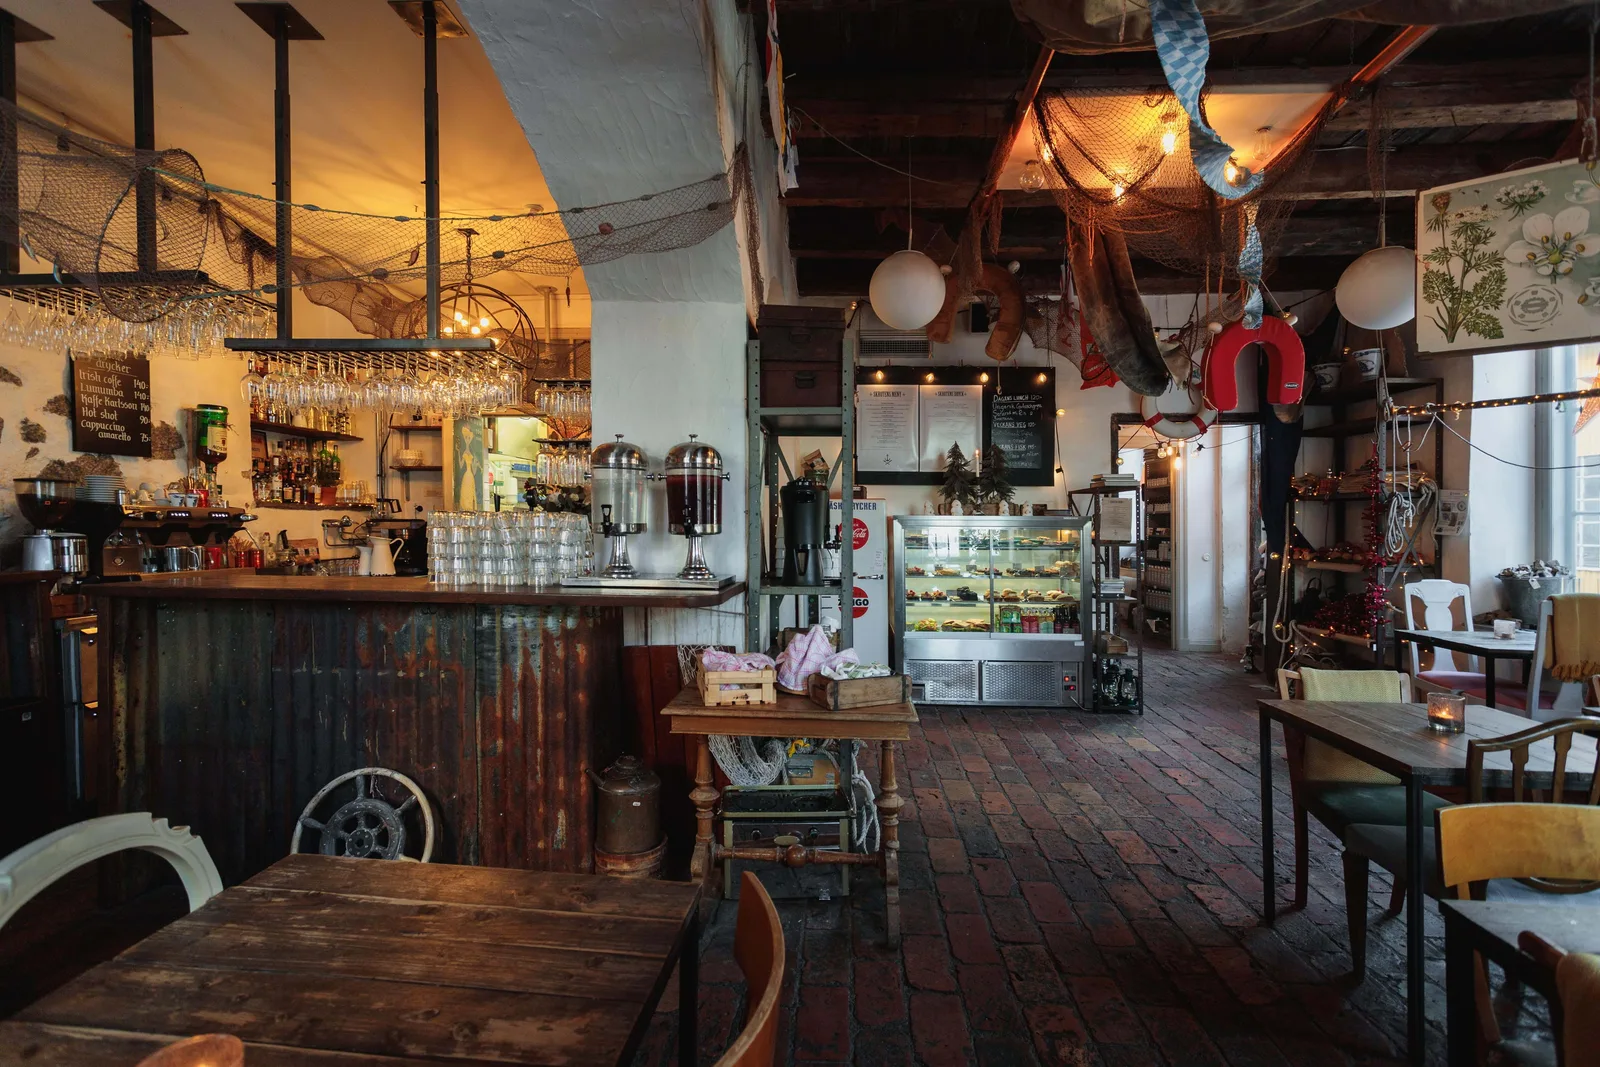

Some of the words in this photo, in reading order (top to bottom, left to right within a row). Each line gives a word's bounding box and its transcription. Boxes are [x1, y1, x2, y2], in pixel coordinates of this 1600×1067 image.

[104, 374, 122, 388] coffe
[80, 382, 124, 398] Lumumba
[81, 394, 102, 408] Kaffe
[105, 396, 138, 411] Karlsson
[82, 407, 97, 418] Hot
[100, 409, 118, 420] shot
[98, 431, 131, 441] amaretto
